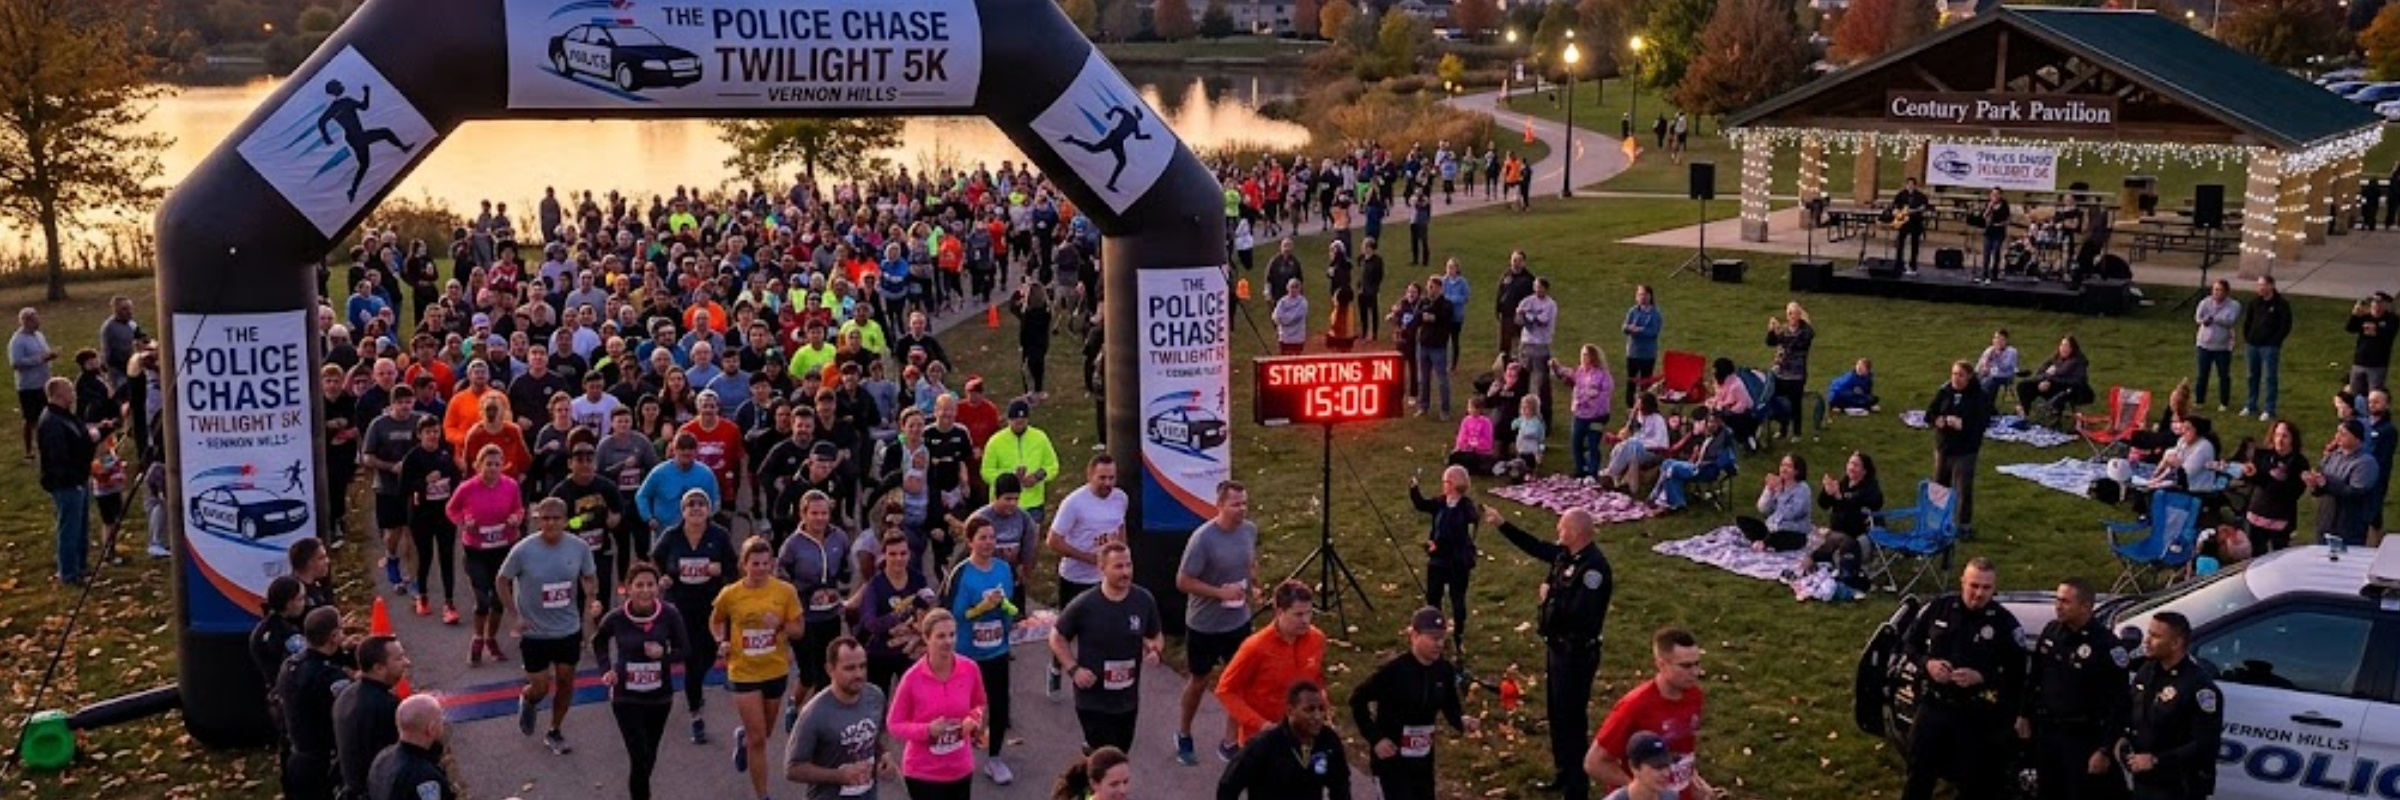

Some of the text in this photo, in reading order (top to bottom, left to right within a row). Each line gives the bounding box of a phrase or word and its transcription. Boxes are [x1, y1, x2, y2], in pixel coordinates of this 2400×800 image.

[662, 6, 950, 42] THE POLICE CHASE
[715, 47, 948, 82] TWILIGHT 5K
[767, 86, 898, 103] VERNON HILLS
[1891, 96, 2111, 124] Century Park Pavilion
[1182, 277, 1205, 292] THE
[1149, 291, 1224, 319] POLICE
[224, 326, 259, 343] THE
[1150, 317, 1224, 348] CHASE
[187, 343, 297, 376] POLICE
[1269, 359, 1393, 386] STARTING IN
[187, 376, 299, 411] CHASE
[1304, 384, 1379, 417] 15:00
[2222, 722, 2350, 750] VERNON HILLS
